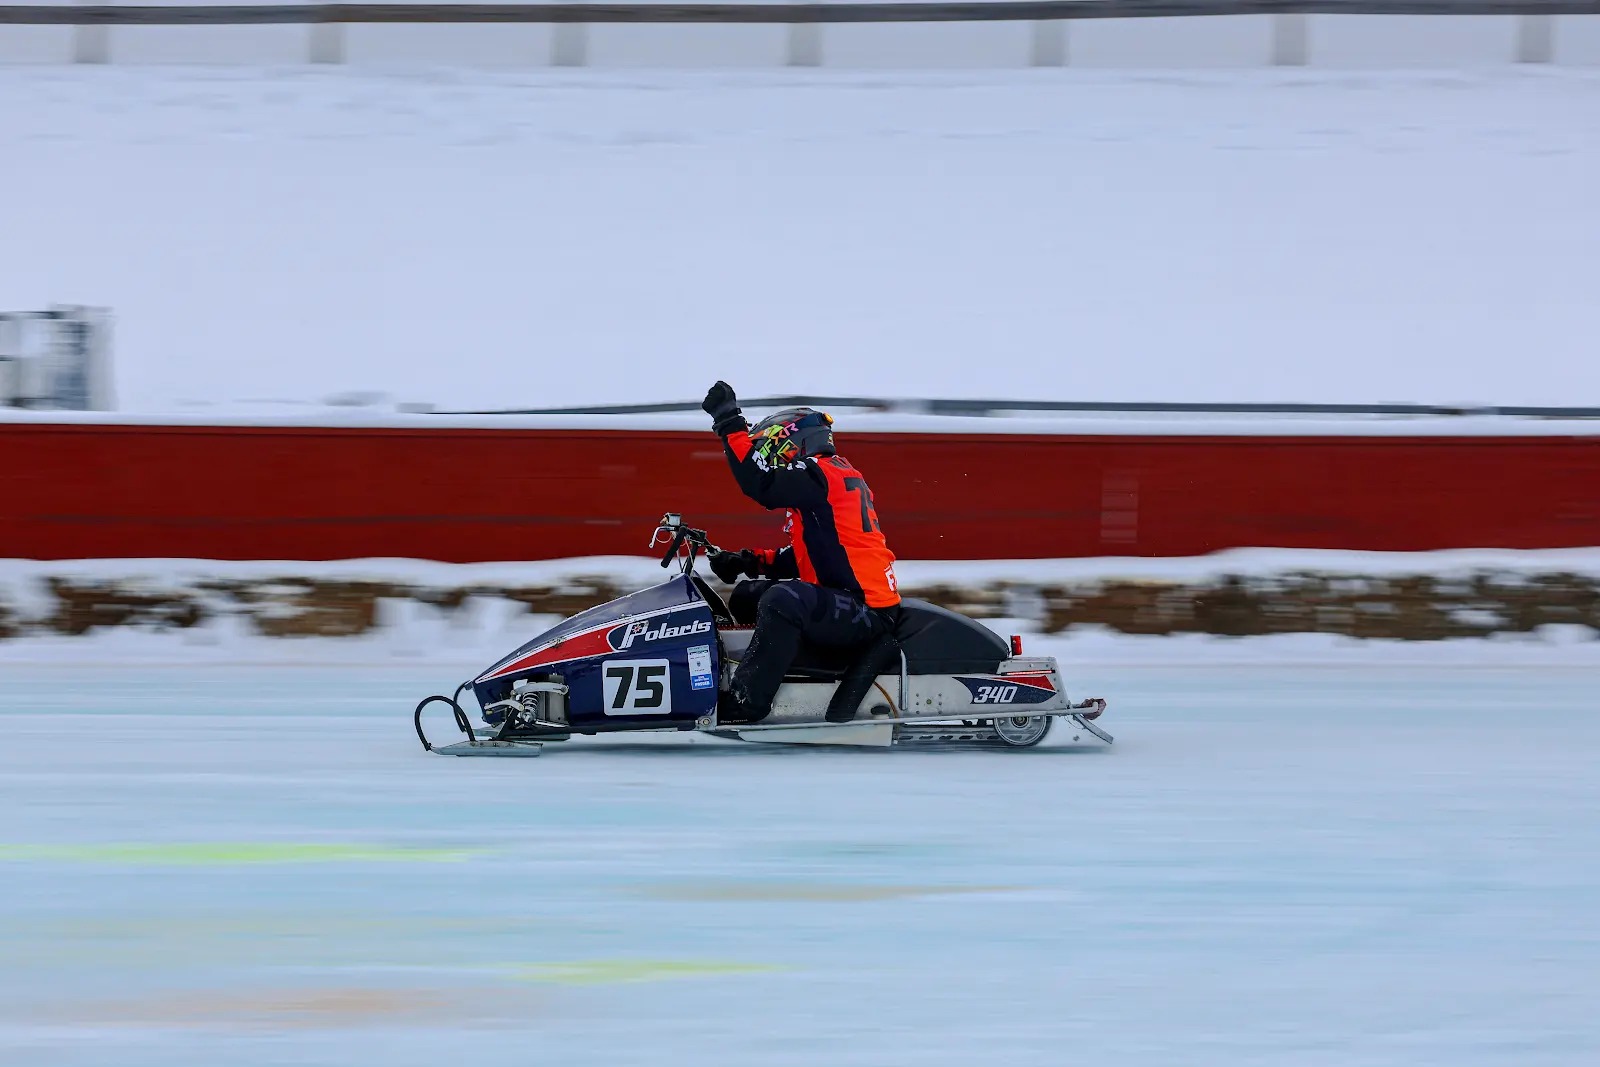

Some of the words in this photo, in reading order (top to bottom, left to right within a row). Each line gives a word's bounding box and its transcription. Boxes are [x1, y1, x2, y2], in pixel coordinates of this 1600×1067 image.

[618, 620, 711, 650] Polaris
[606, 666, 666, 708] 75
[973, 686, 1018, 703] 340
